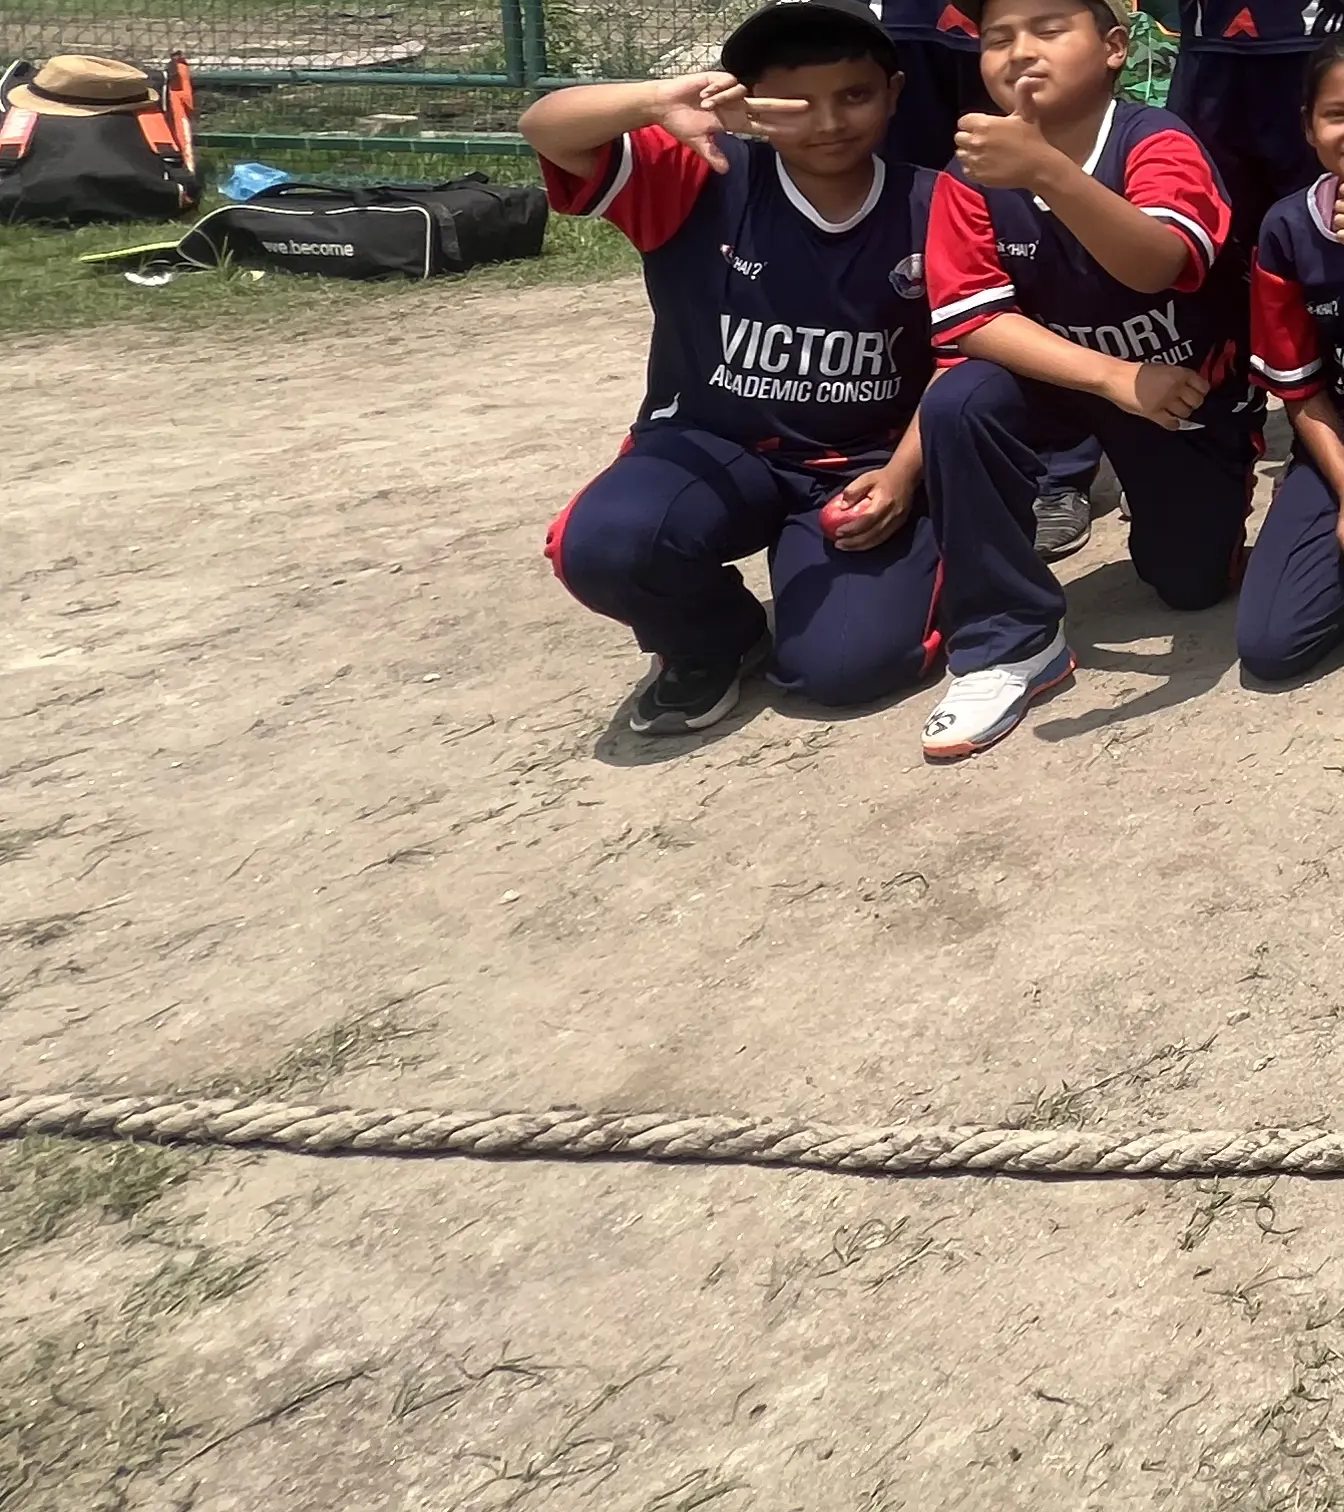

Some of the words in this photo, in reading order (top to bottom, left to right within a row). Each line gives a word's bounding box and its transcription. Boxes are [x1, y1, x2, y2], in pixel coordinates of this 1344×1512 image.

[719, 313, 904, 377] VICTORY
[1047, 299, 1182, 360] TORY
[708, 363, 812, 403] ACADEMIC
[815, 375, 902, 404] CONSULT
